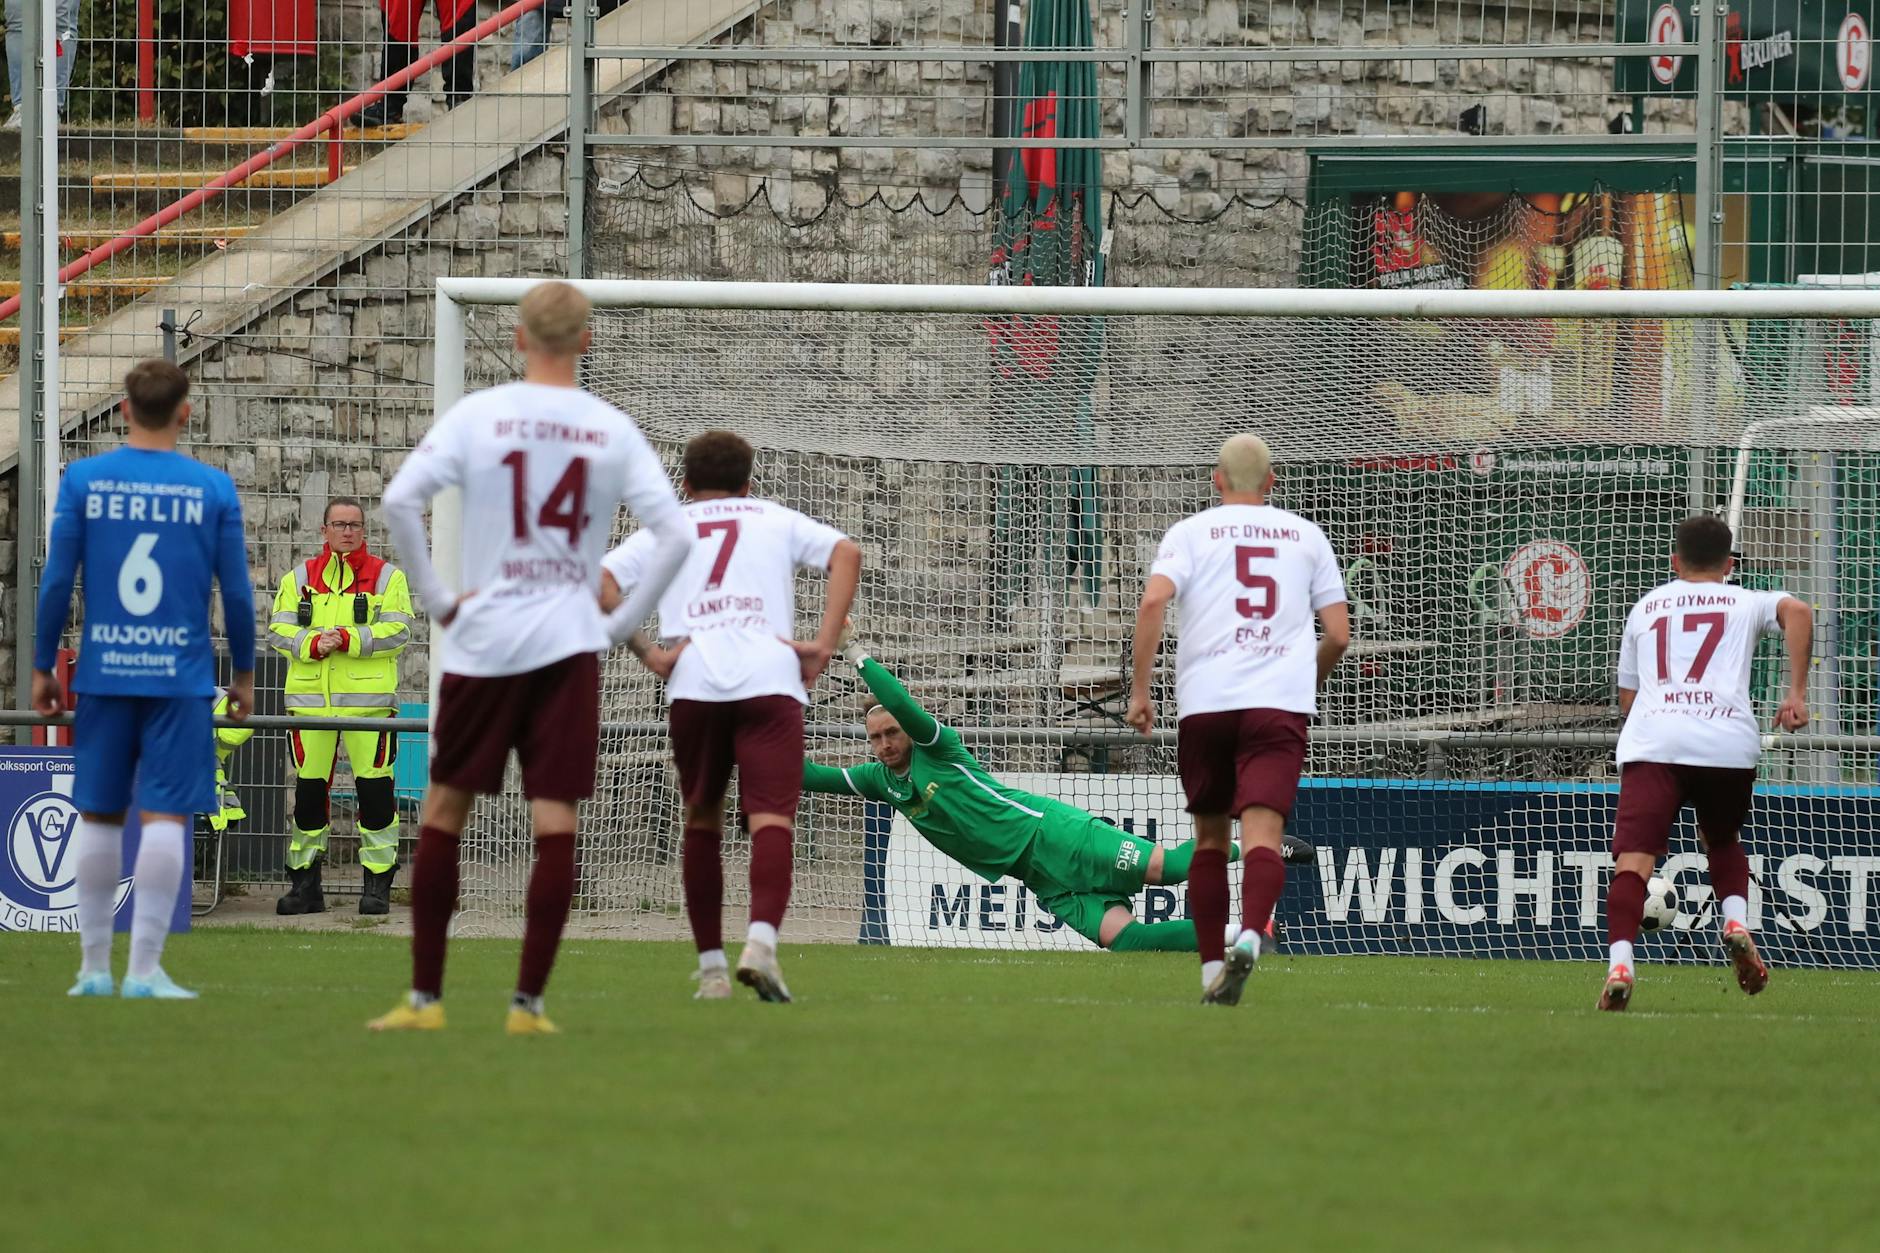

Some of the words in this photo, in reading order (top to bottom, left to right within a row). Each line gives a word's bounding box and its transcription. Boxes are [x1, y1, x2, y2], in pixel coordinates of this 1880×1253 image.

[1741, 30, 1793, 70] BERLINER
[85, 493, 204, 526] BERLIN
[501, 449, 591, 549] 14
[1210, 525, 1239, 540] BFC
[1243, 525, 1300, 542] DYNAMO
[697, 519, 739, 592] 7
[117, 532, 164, 617] 6
[1235, 544, 1277, 620] 5
[687, 596, 764, 618] LANKFORD
[1645, 598, 1672, 615] BFC
[1676, 595, 1736, 608] DYNAMO
[91, 623, 190, 647] KUJOVIC
[1649, 612, 1726, 686] 17
[102, 649, 176, 667] structure
[1664, 691, 1714, 705] MEYER
[0, 760, 43, 774] olkssport
[1315, 845, 1714, 930] WICHTG
[928, 884, 1191, 933] MEISR
